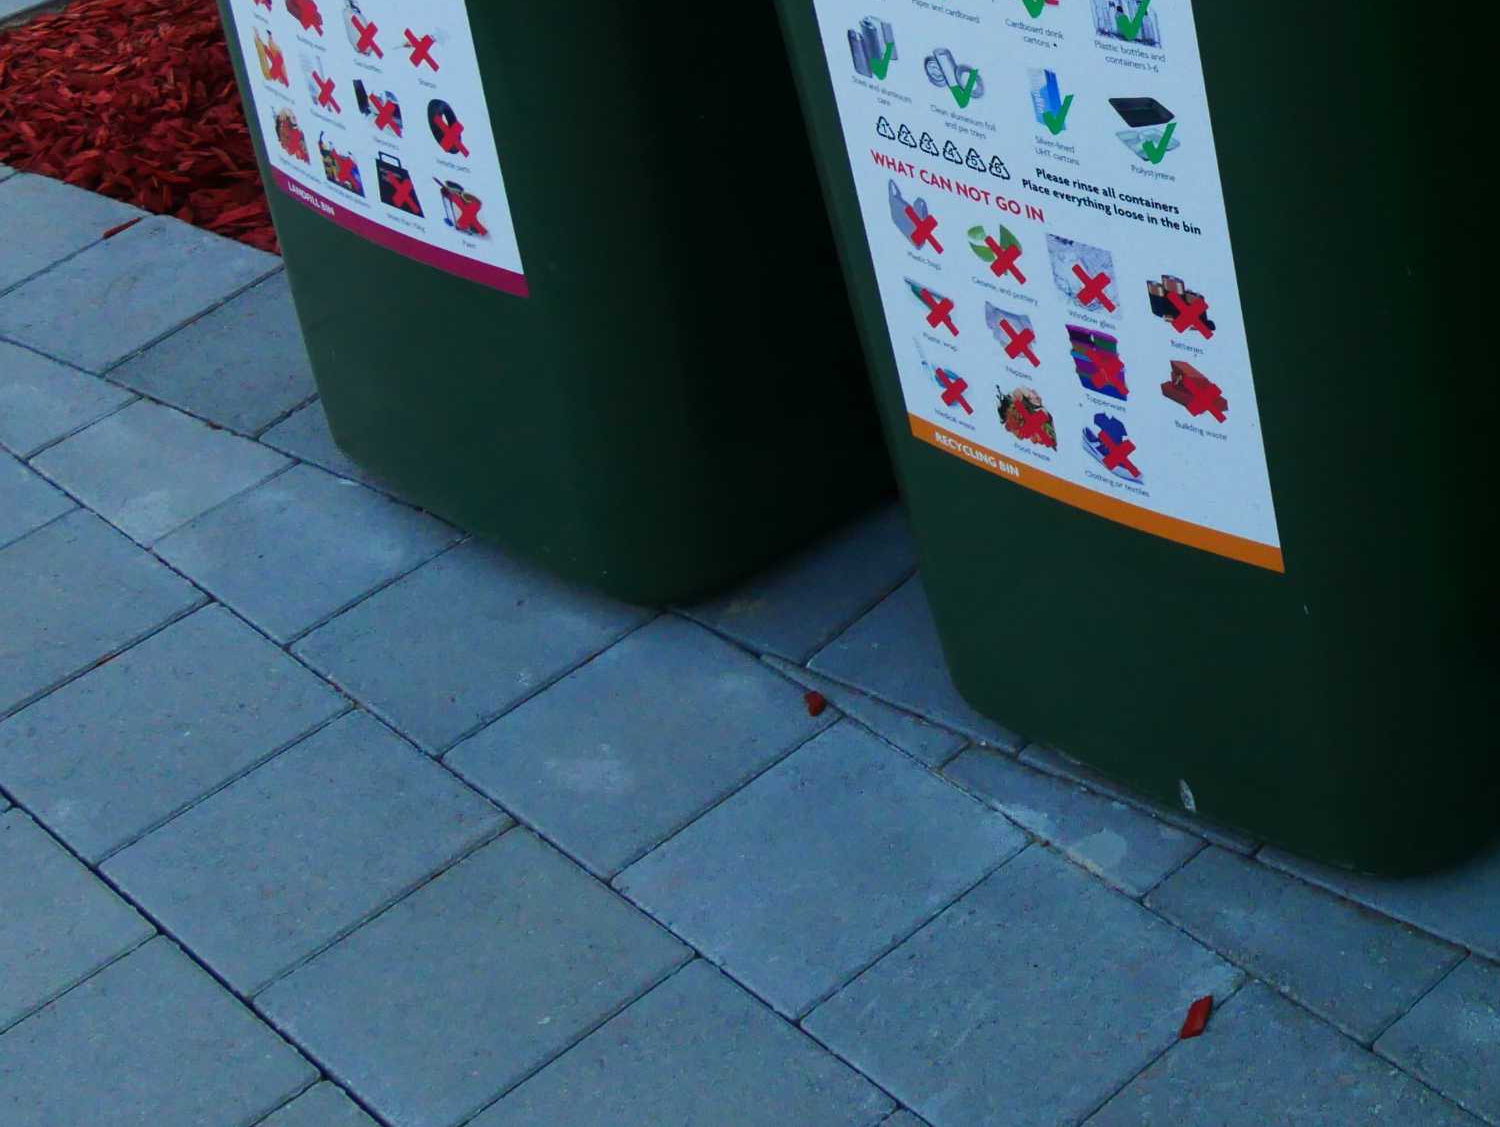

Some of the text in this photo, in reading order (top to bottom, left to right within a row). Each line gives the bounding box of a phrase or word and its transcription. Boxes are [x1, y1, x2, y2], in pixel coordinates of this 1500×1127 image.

[1094, 39, 1166, 63] Plastic bottles and
[1105, 56, 1146, 71] containers
[871, 150, 1045, 223] WHAT CAN NOT GO IN
[1021, 179, 1202, 235] Place everything loose in the bin
[1036, 169, 1180, 215] Please rinse all containers
[935, 431, 1020, 478] RECYCLING BIN
